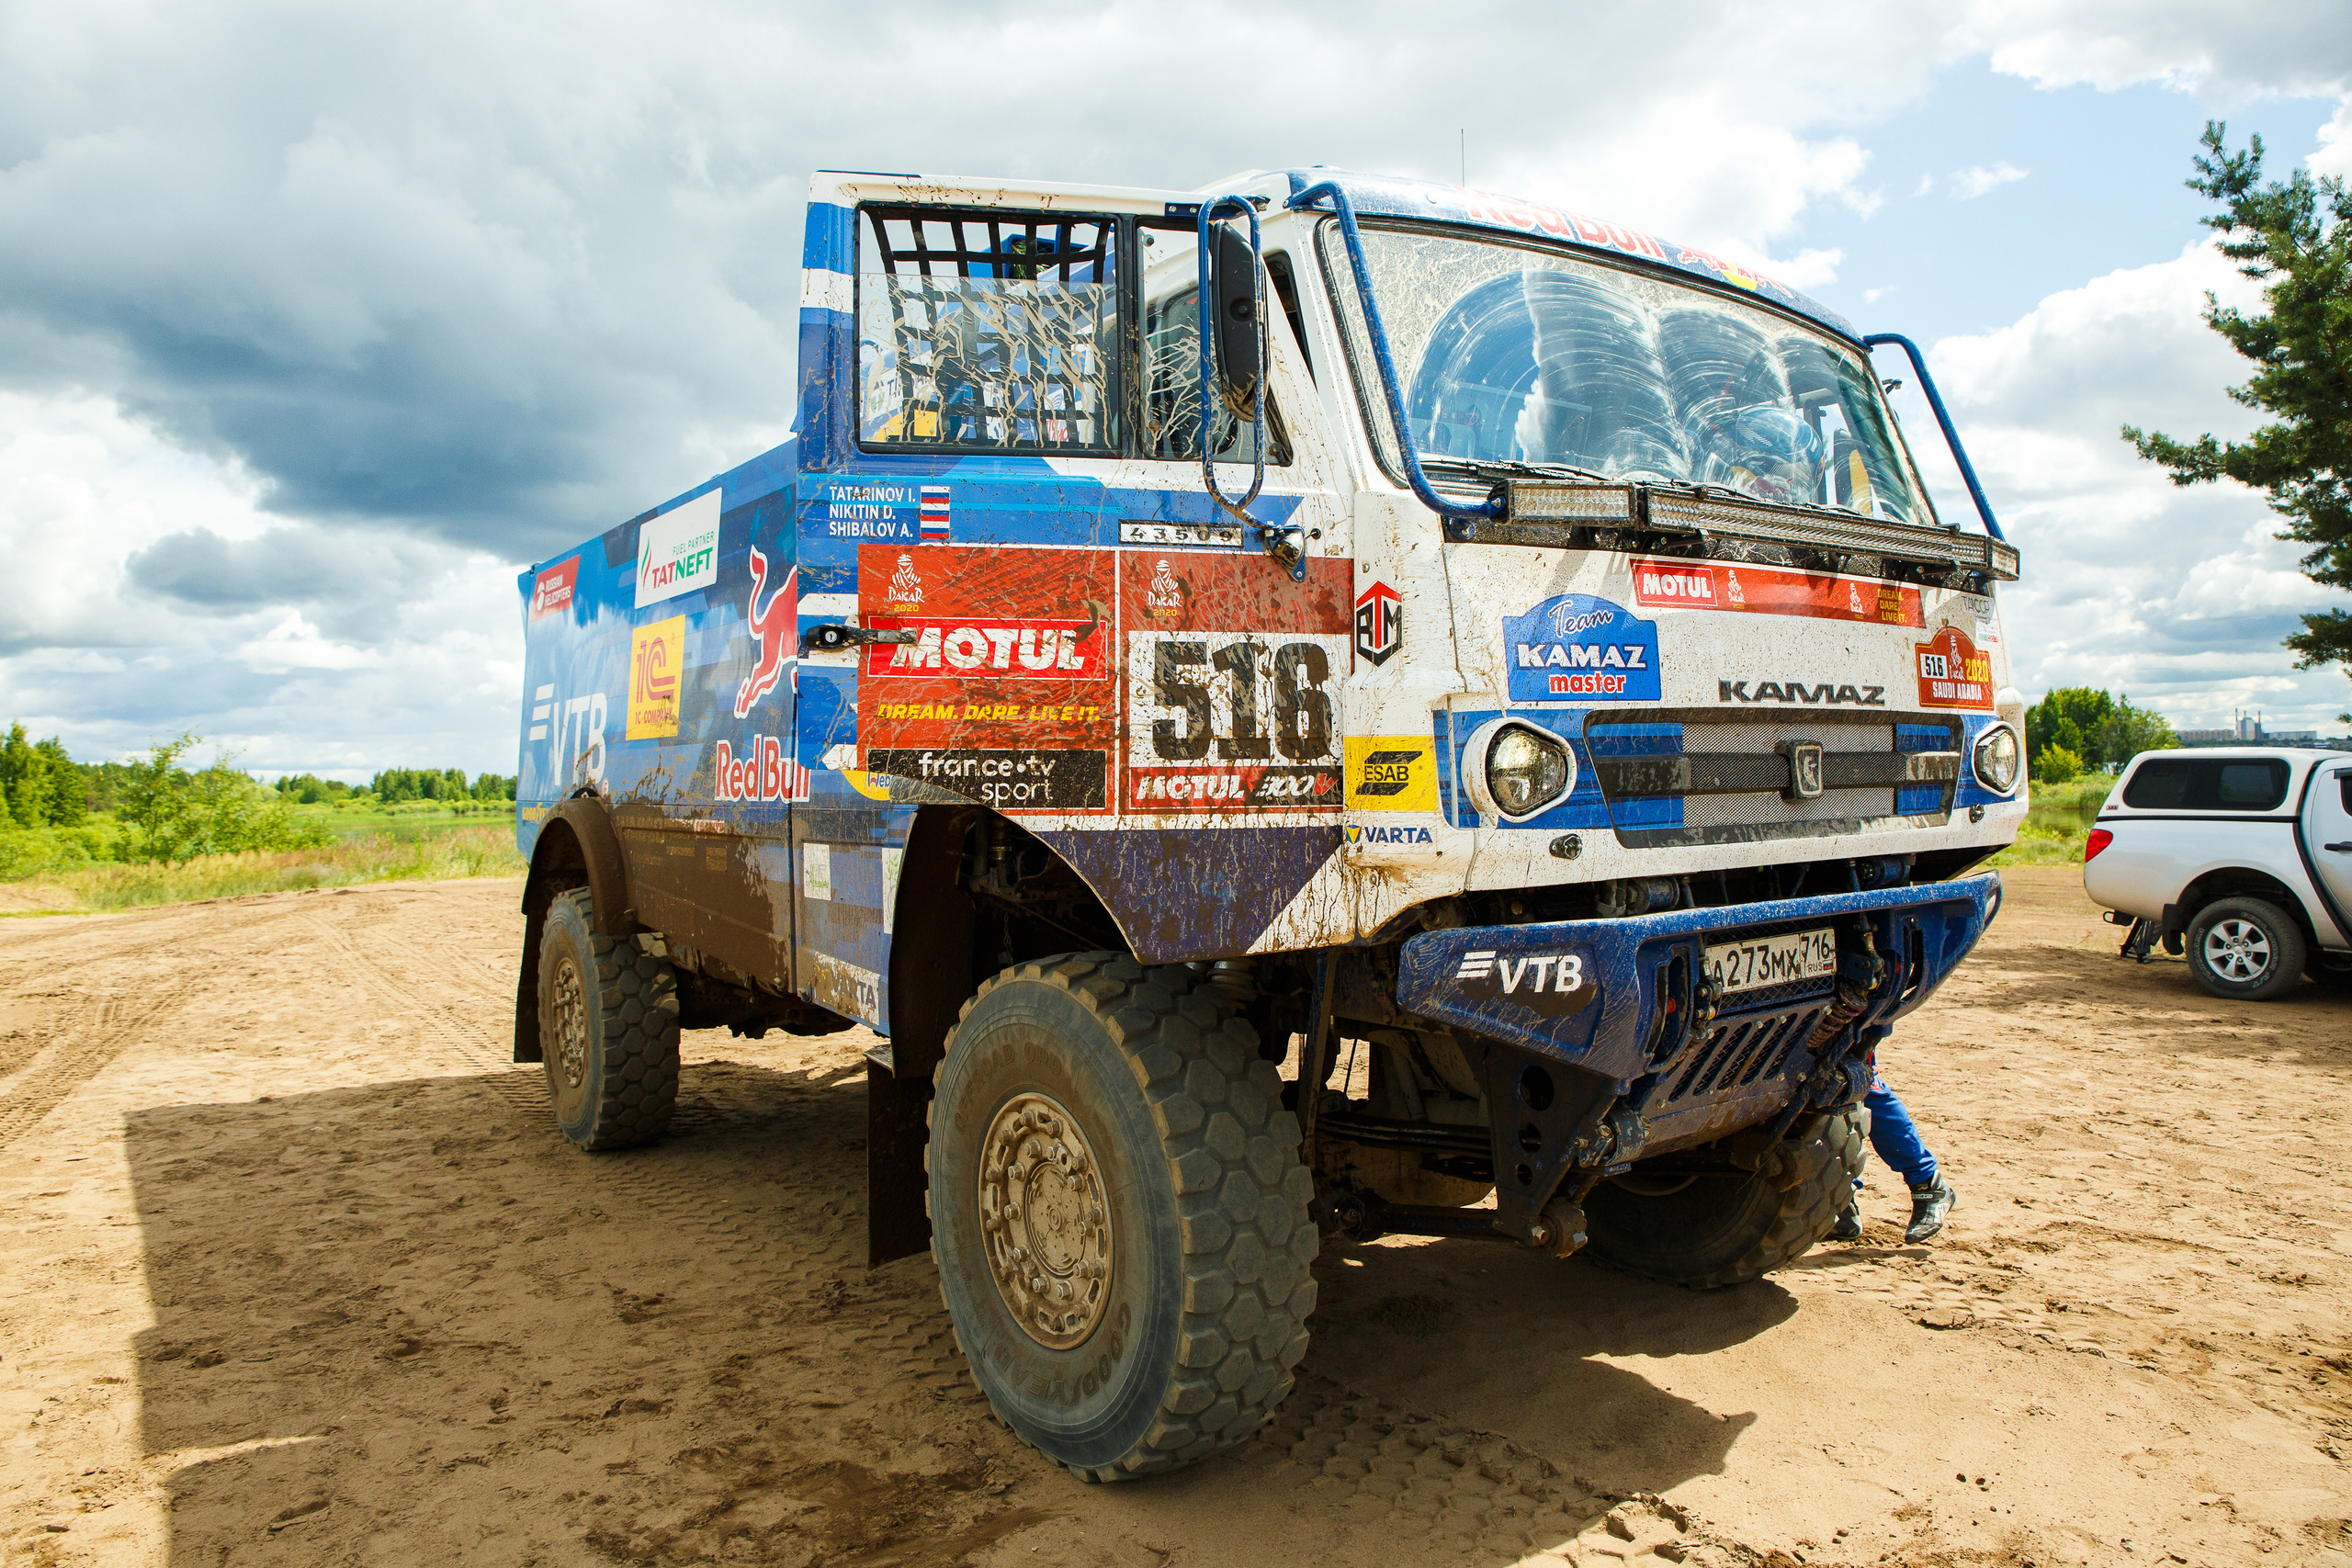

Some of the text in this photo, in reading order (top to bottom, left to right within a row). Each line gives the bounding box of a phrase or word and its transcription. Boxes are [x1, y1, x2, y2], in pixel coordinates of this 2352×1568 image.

[830, 486, 916, 502] TATARINOV I.
[829, 504, 896, 520] NIKITIN D.
[829, 523, 913, 537] SHIBALOV A.
[1130, 527, 1234, 542] 43509
[673, 531, 714, 557] FUEL PARTNER
[652, 547, 713, 589] TATNEFT
[888, 586, 925, 604] DAKAR
[1643, 573, 1712, 598] MOTUL
[1877, 589, 1904, 601] DREAM.
[894, 604, 920, 613] 2020
[1148, 591, 1182, 608] DAKAR
[1879, 600, 1900, 611] DARE.
[1547, 599, 1613, 637] Team
[1882, 611, 1897, 622] LIVE
[889, 626, 1087, 671] MOTUL
[1516, 643, 1648, 671] KAMAZ
[1925, 656, 1944, 677] 516
[1965, 659, 1989, 682] 2020
[1549, 671, 1626, 694] master
[1718, 679, 1885, 705] KAMAZ
[1932, 681, 1982, 701] SAUDI ARABIA
[1152, 641, 1333, 761] 516
[643, 707, 673, 724] COMPANY
[877, 705, 958, 719] DREAM.
[553, 692, 607, 786] VTB
[1364, 765, 1409, 782] ESAB
[980, 780, 1054, 808] sport
[1136, 774, 1245, 800] MOTUL
[1364, 827, 1433, 843] VARTA
[1801, 933, 1830, 964] 716
[1498, 953, 1583, 994] VTB
[1808, 961, 1823, 973] RUS
